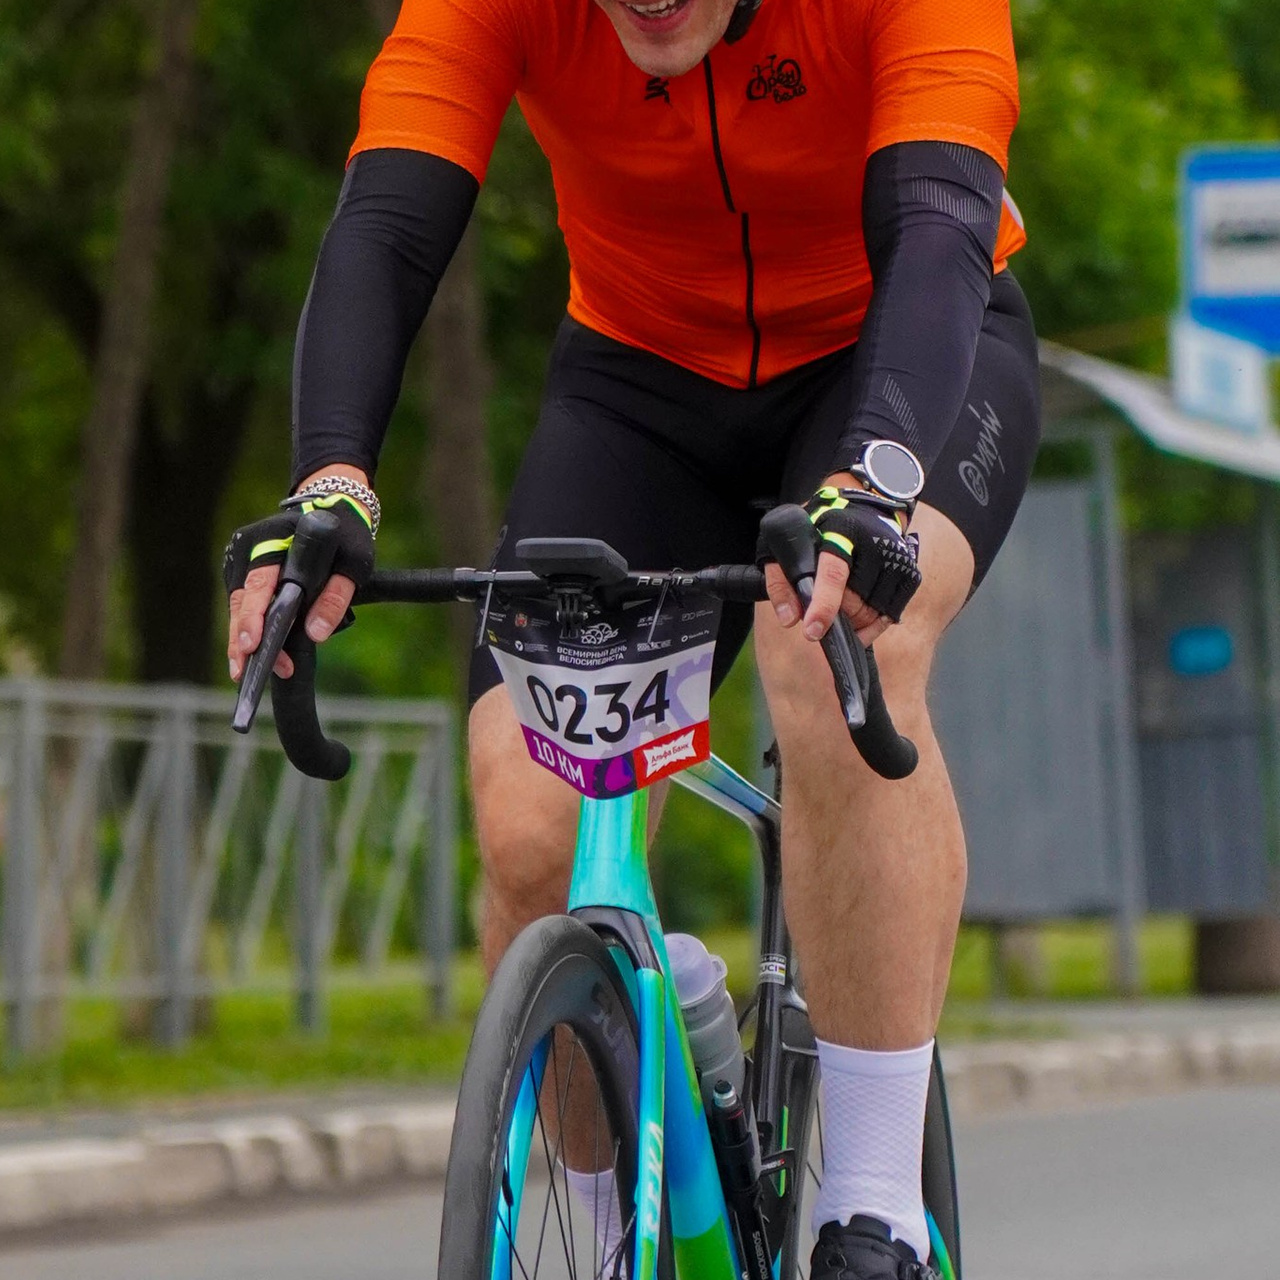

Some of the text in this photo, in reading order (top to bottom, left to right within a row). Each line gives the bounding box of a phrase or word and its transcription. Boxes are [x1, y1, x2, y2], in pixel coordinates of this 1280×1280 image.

[556, 646, 609, 659] ВСЕМИРНЫЙ
[609, 645, 628, 656] ДЕНЬ
[559, 653, 624, 666] ВЕЛОСИПЕДИСТА
[526, 669, 670, 745] 0234
[532, 735, 555, 767] 10
[651, 743, 690, 764] Альфа Банк
[752, 1230, 769, 1280] ROCKBROS
